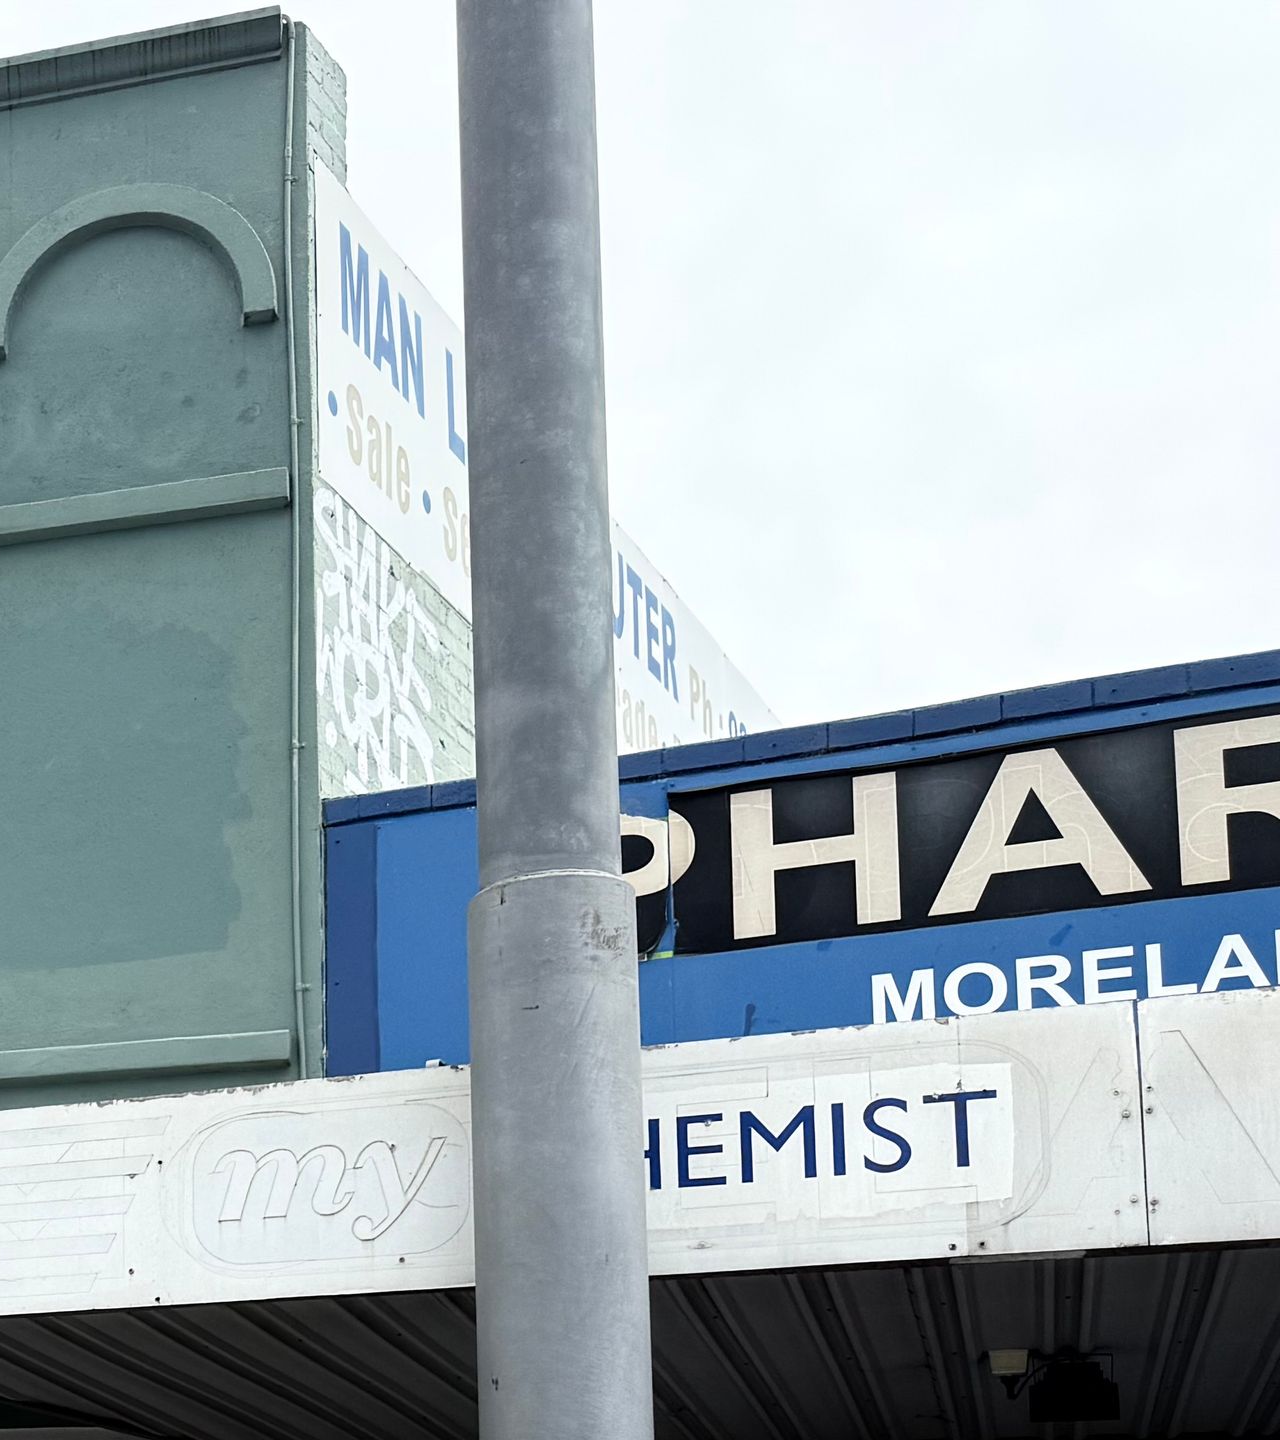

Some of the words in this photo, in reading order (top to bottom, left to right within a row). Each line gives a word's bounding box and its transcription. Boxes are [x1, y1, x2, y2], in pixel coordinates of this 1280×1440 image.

[339, 219, 425, 420] MAN
[346, 383, 411, 514] Sale
[612, 550, 679, 704] UTER
[871, 928, 1280, 1025] MORELA
[644, 1089, 998, 1191] EMIST
